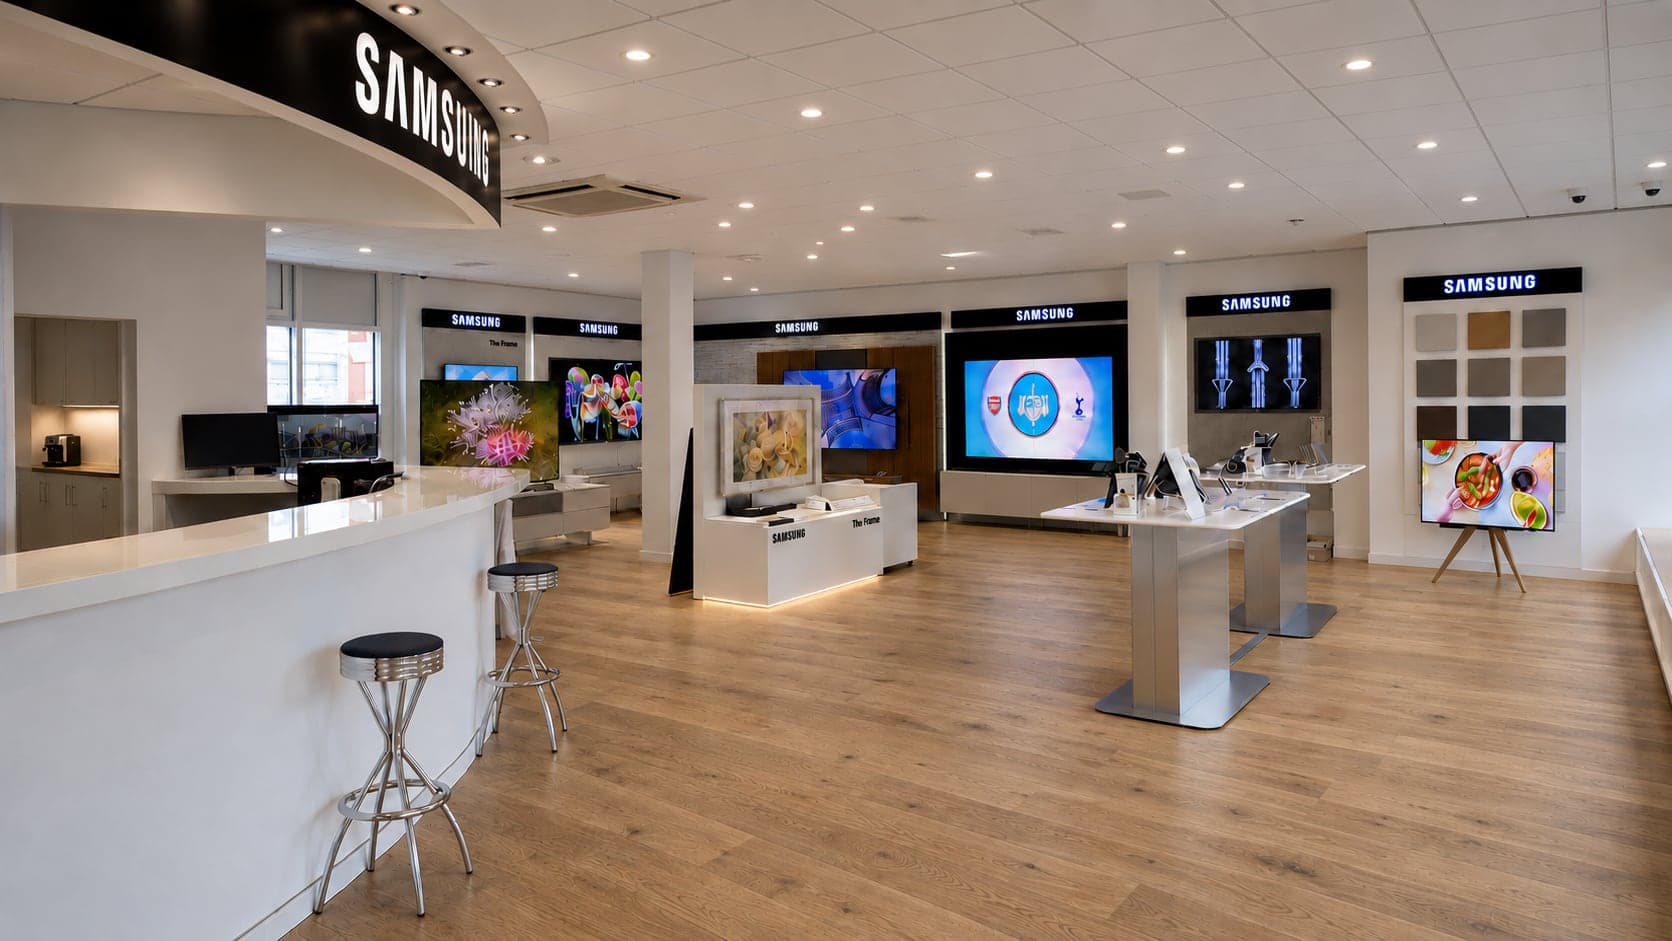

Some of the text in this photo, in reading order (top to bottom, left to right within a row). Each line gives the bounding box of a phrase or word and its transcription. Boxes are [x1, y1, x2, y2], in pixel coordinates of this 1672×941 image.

[1443, 274, 1537, 295] SAMSUNG
[1221, 294, 1291, 311] SAMSUNG
[451, 314, 501, 328] SAMSUNG
[1015, 307, 1074, 321] SAMSUNG
[579, 323, 618, 335] SAMSUNG
[775, 321, 819, 334] SAMSUNG
[772, 528, 806, 544] SAMSUNG
